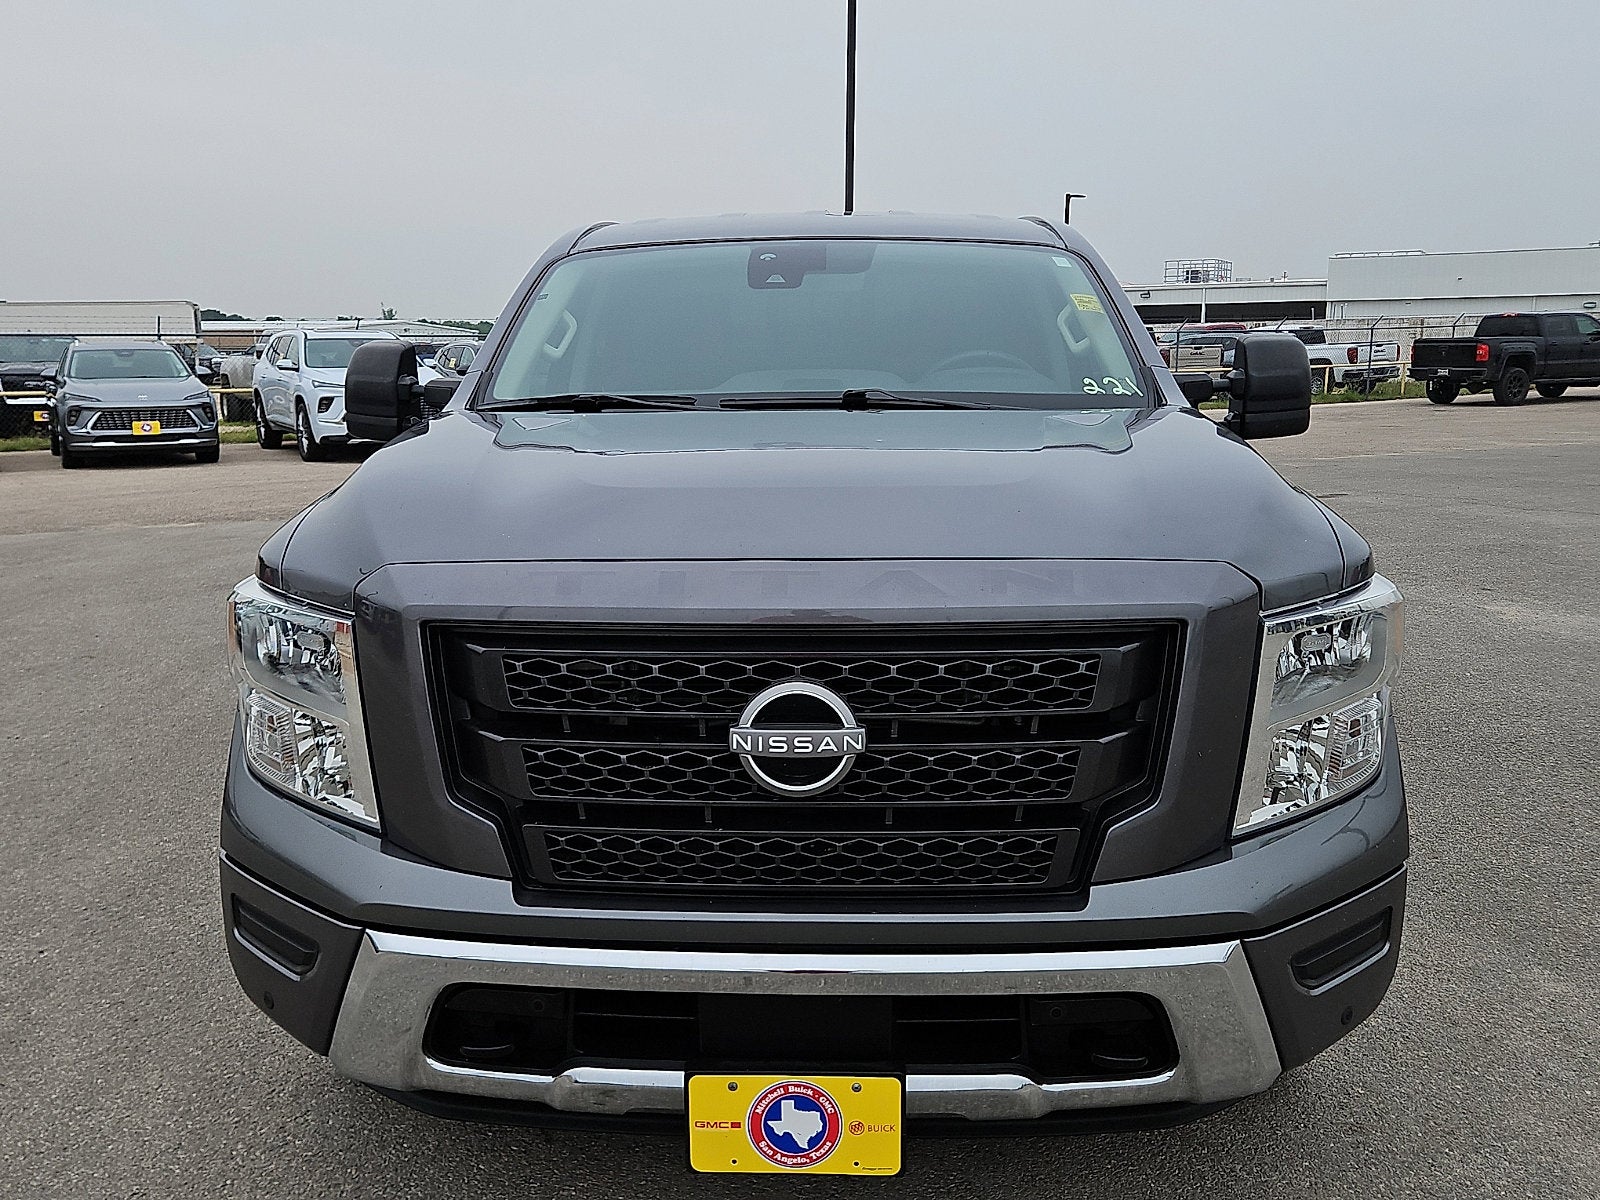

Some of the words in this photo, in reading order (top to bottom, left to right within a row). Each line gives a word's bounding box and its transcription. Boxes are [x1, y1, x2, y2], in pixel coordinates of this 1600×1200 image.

[1083, 376, 1144, 397] 221
[527, 568, 1084, 598] TITAN
[732, 733, 863, 753] NISSAN
[755, 1087, 785, 1115] Mitchell
[788, 1085, 814, 1097] Buick
[819, 1096, 835, 1115] GMC
[694, 1120, 730, 1129] GMC
[867, 1124, 896, 1133] BUICK
[758, 1140, 774, 1157] San
[773, 1152, 810, 1165] Angelo,
[808, 1141, 833, 1160] Texas
